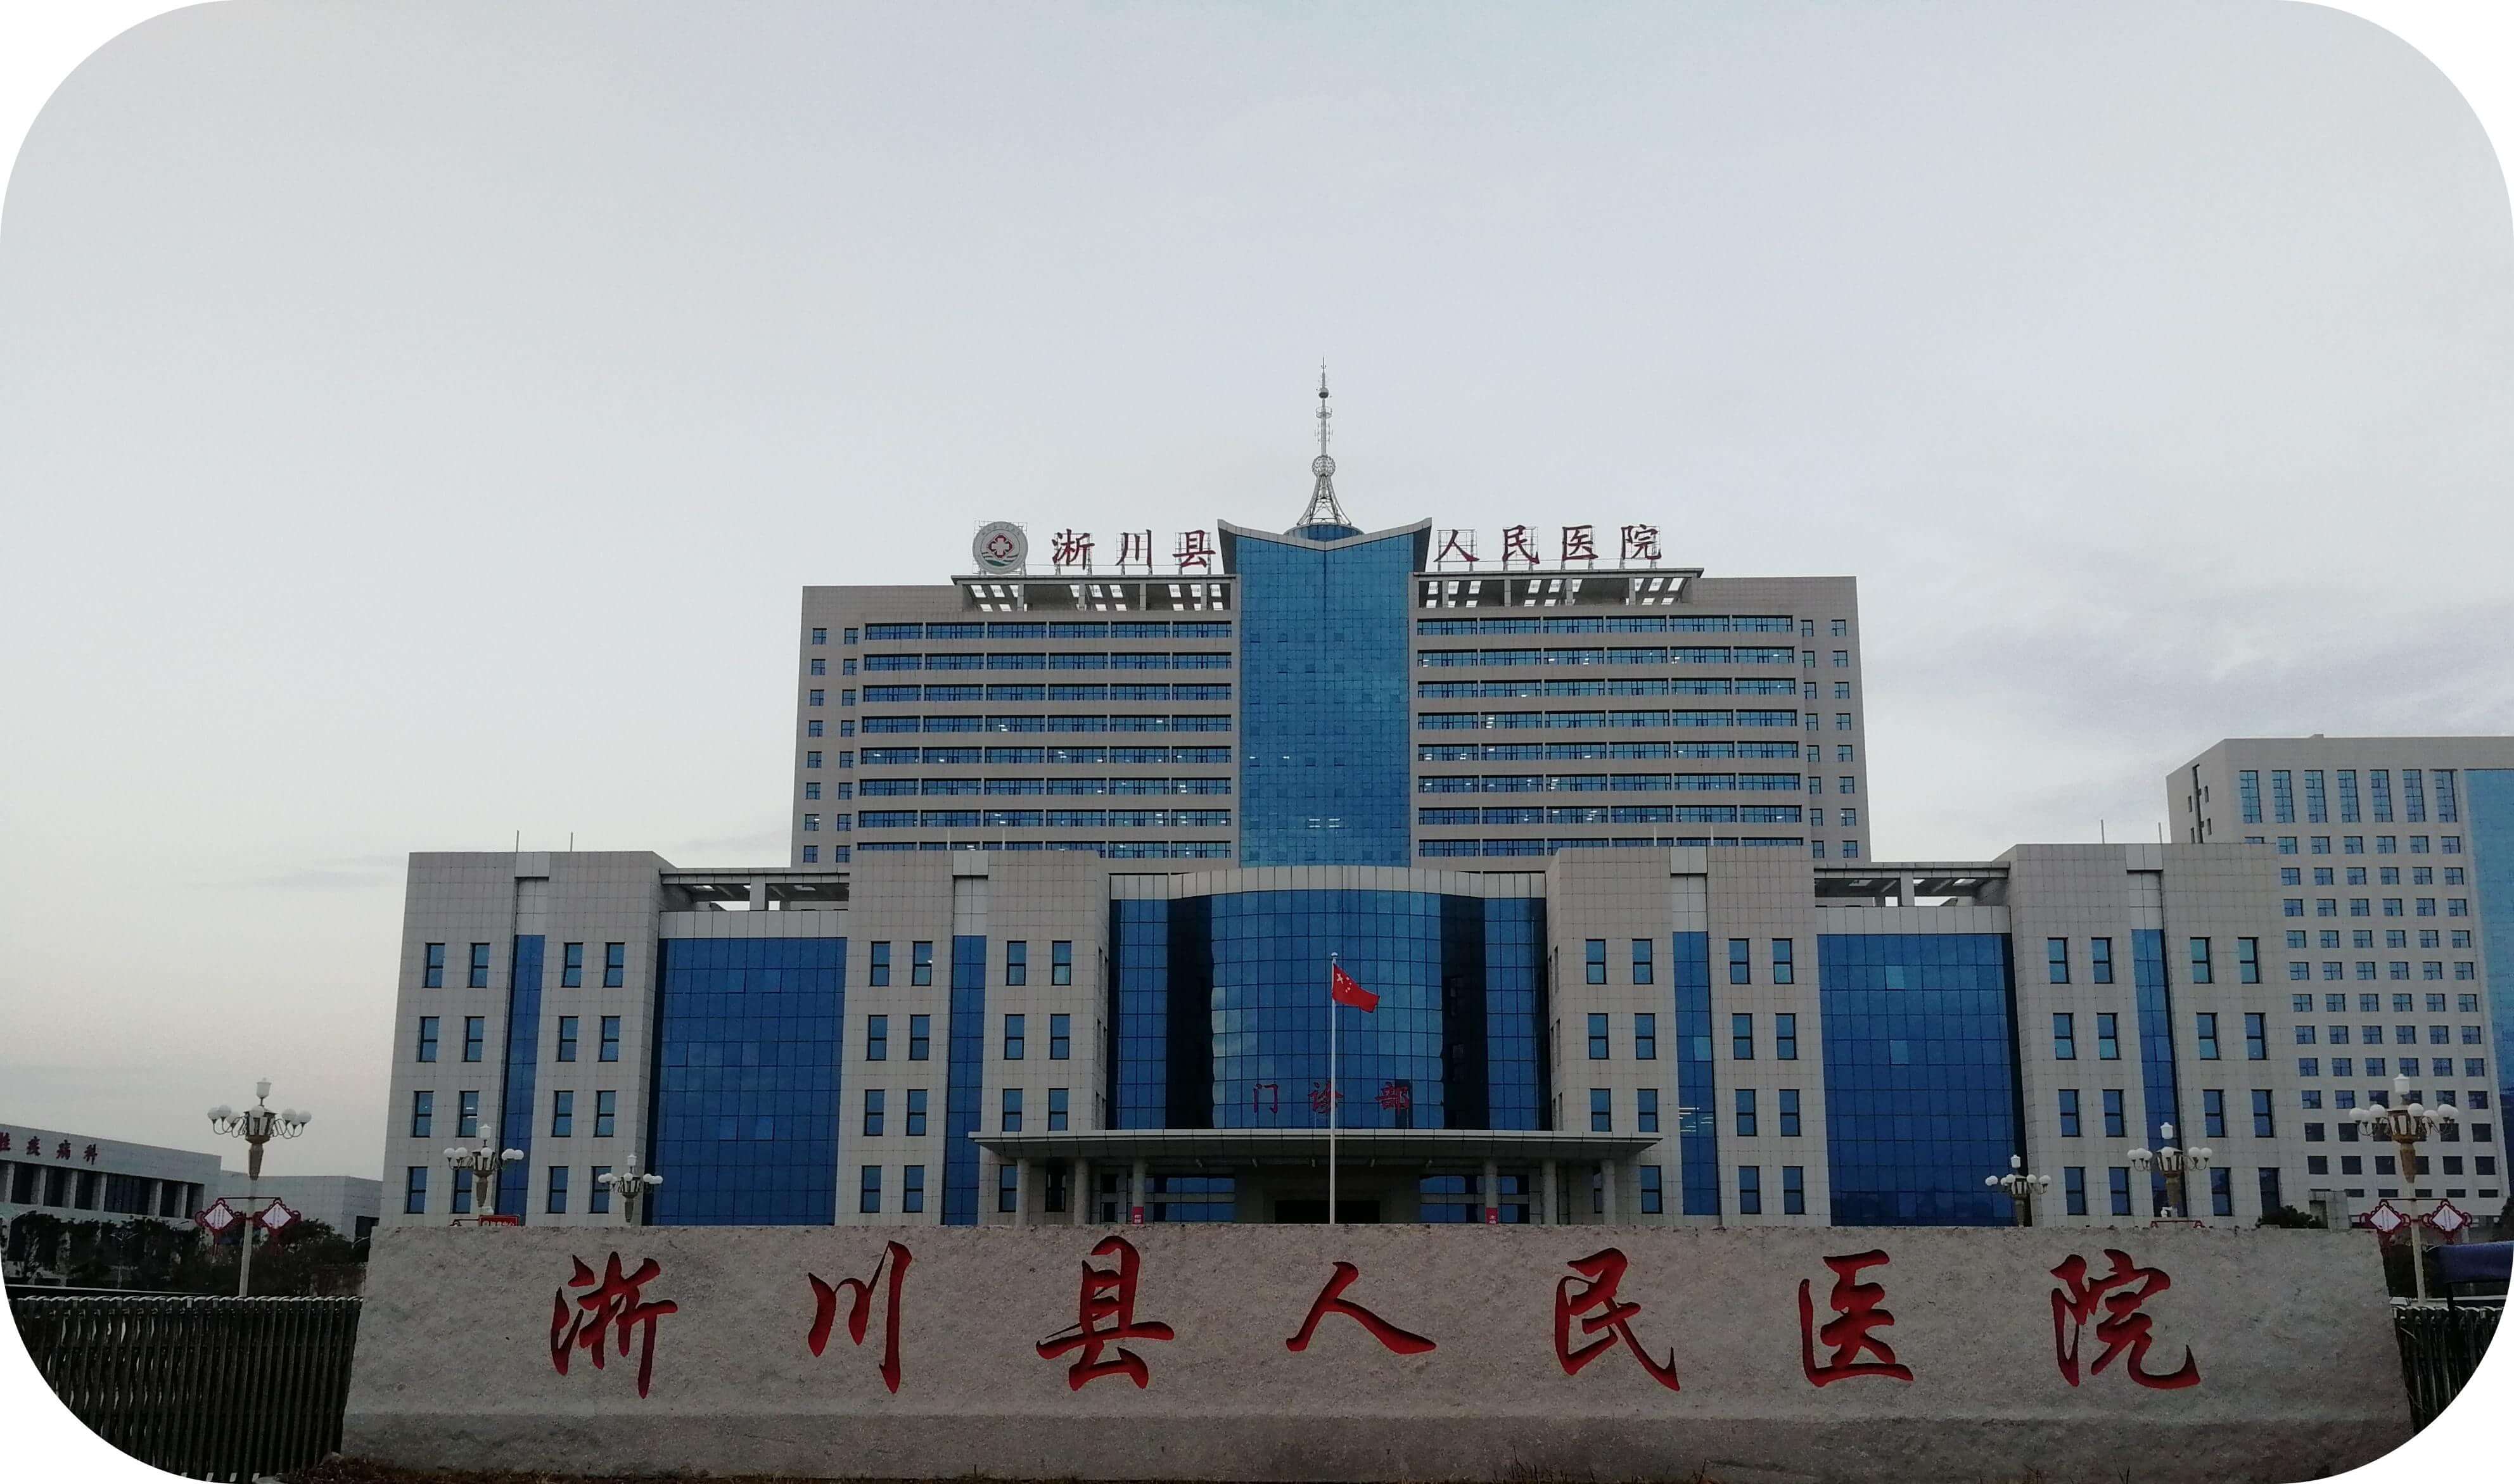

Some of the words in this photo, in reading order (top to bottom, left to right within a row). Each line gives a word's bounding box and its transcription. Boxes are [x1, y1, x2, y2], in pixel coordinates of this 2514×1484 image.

[1051, 528, 1216, 571] 淅川县
[1433, 524, 1663, 564] 人民医院
[1253, 1080, 1410, 1115] 门诊部
[549, 1235, 2200, 1400] 淅川县人民医院
